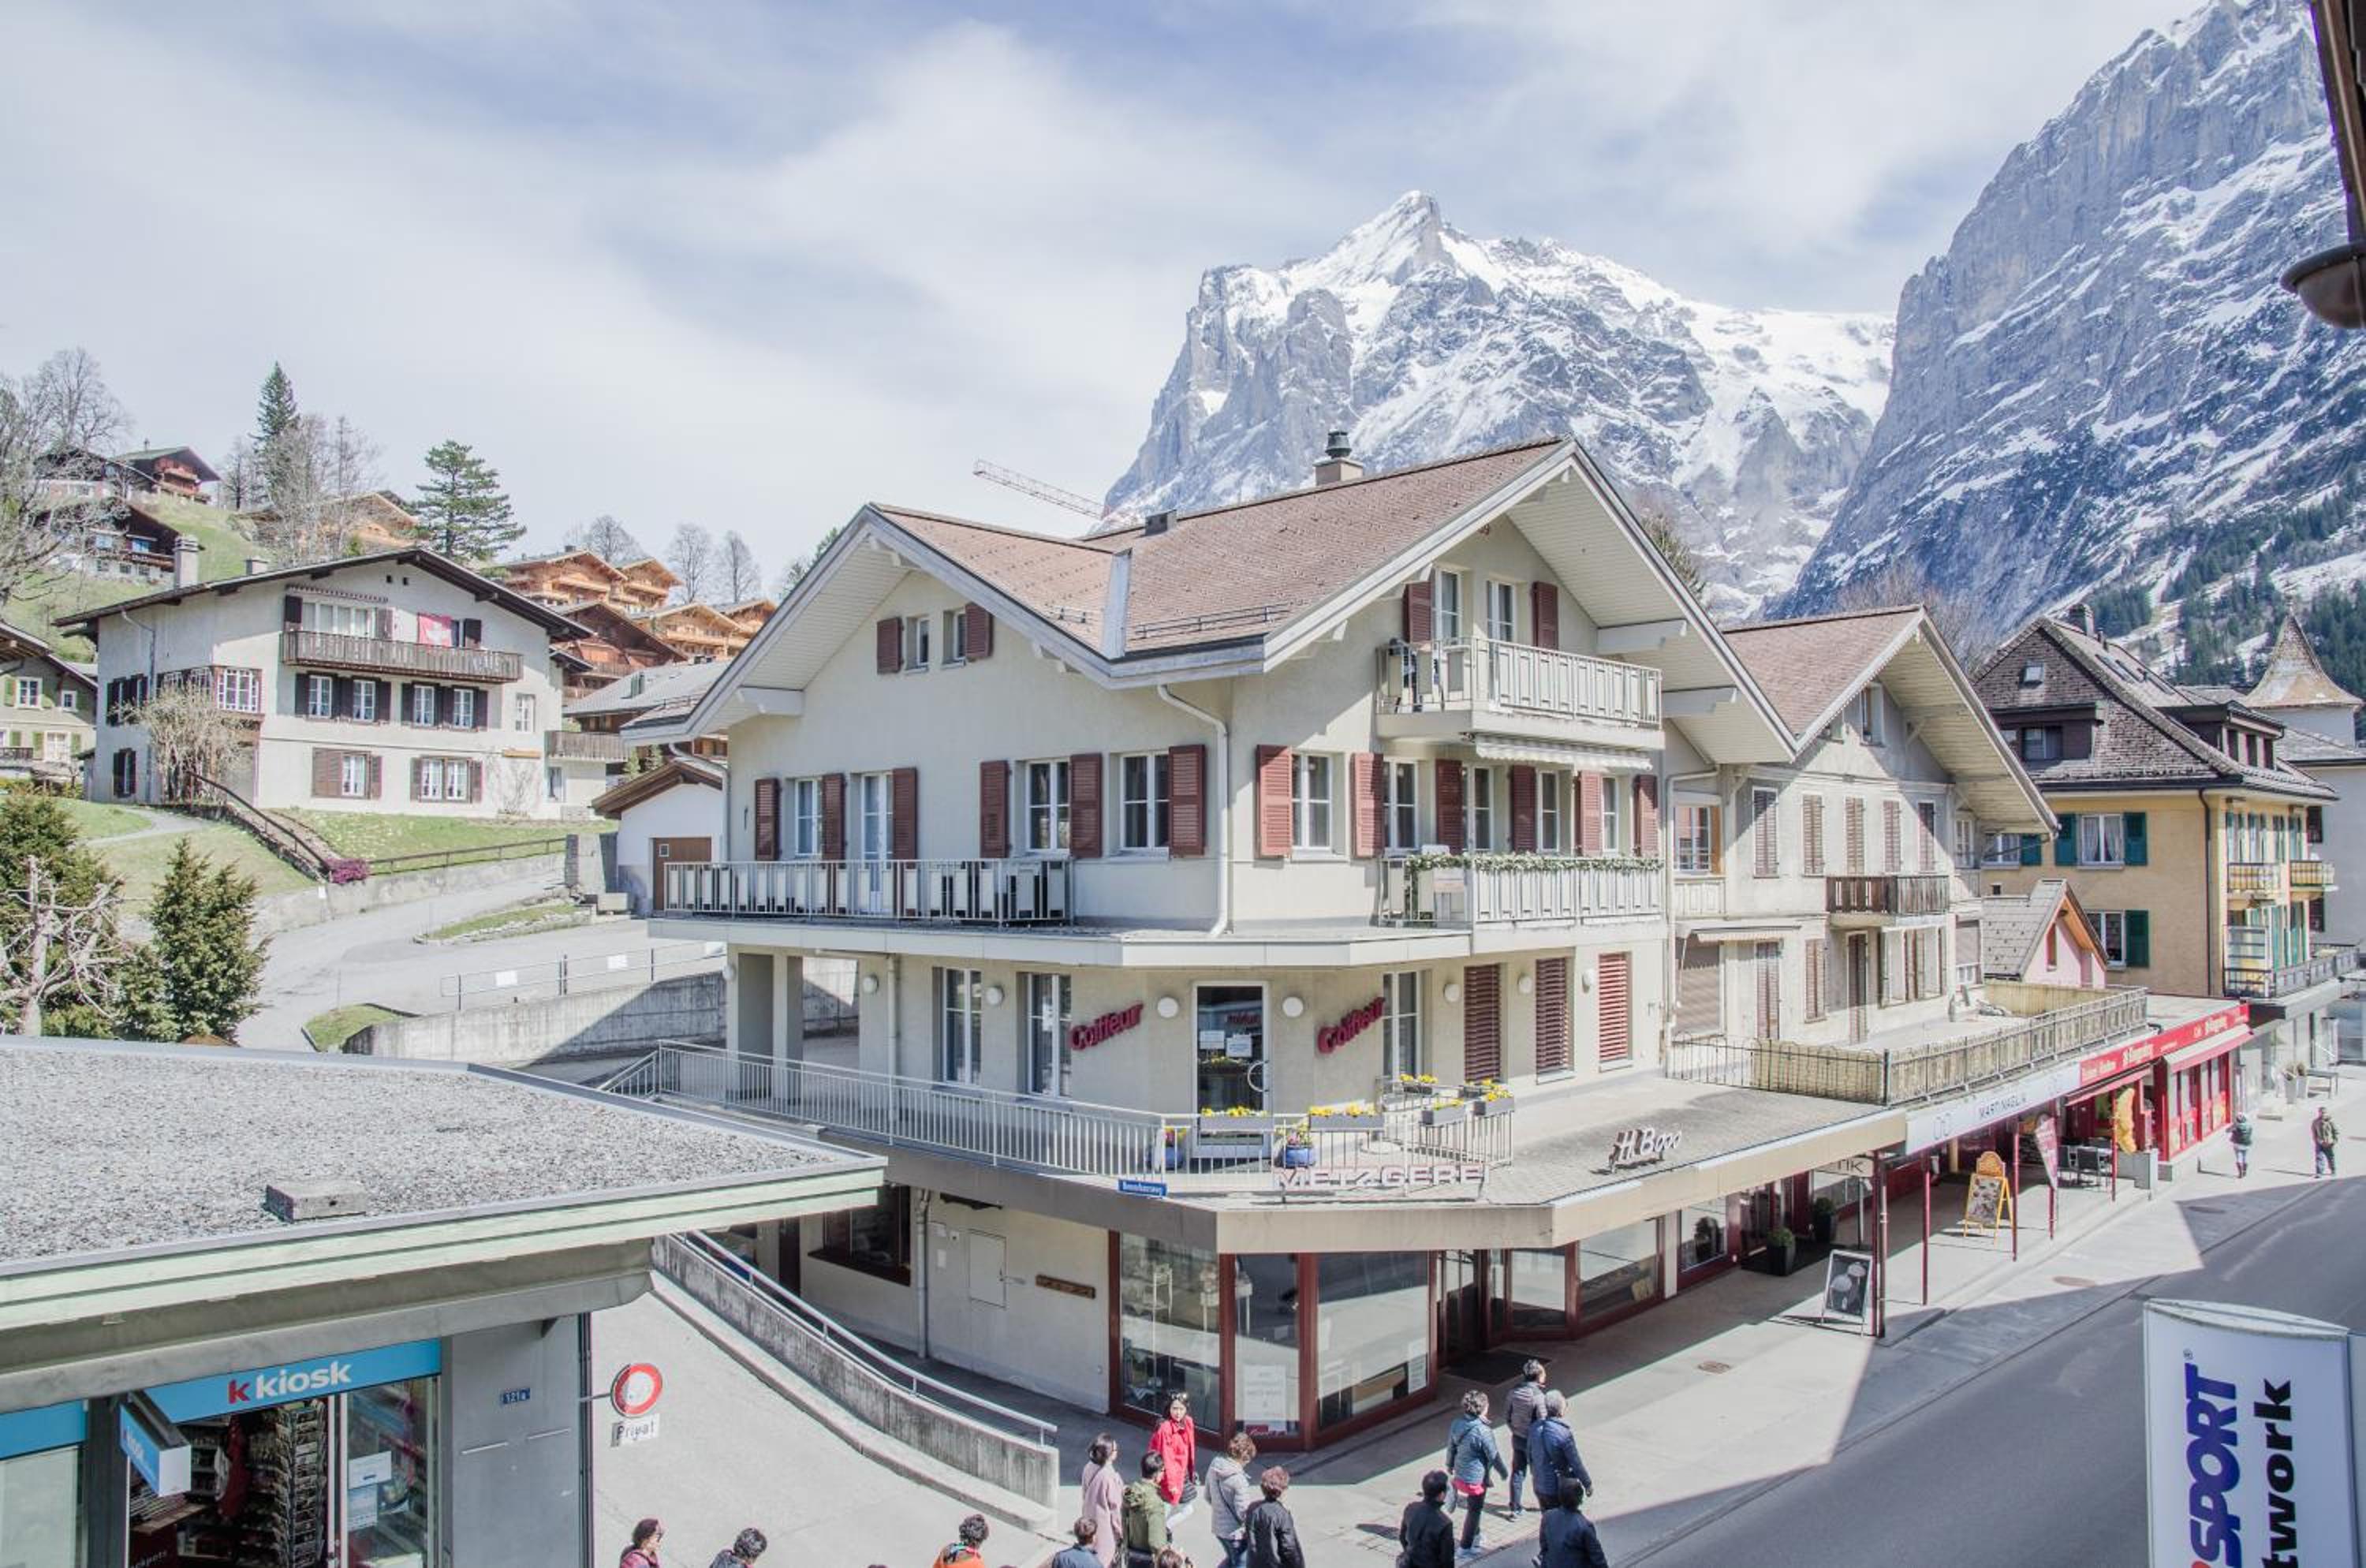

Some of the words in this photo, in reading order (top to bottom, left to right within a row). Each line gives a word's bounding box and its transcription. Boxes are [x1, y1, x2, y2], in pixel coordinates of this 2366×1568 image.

[1069, 1002, 1144, 1051] Coiffeur
[1318, 996, 1386, 1054] Coiffeur
[228, 1379, 252, 1405] k
[256, 1361, 352, 1400] kiosk
[618, 1422, 655, 1440] Privat
[2184, 1362, 2243, 1568] SPORT
